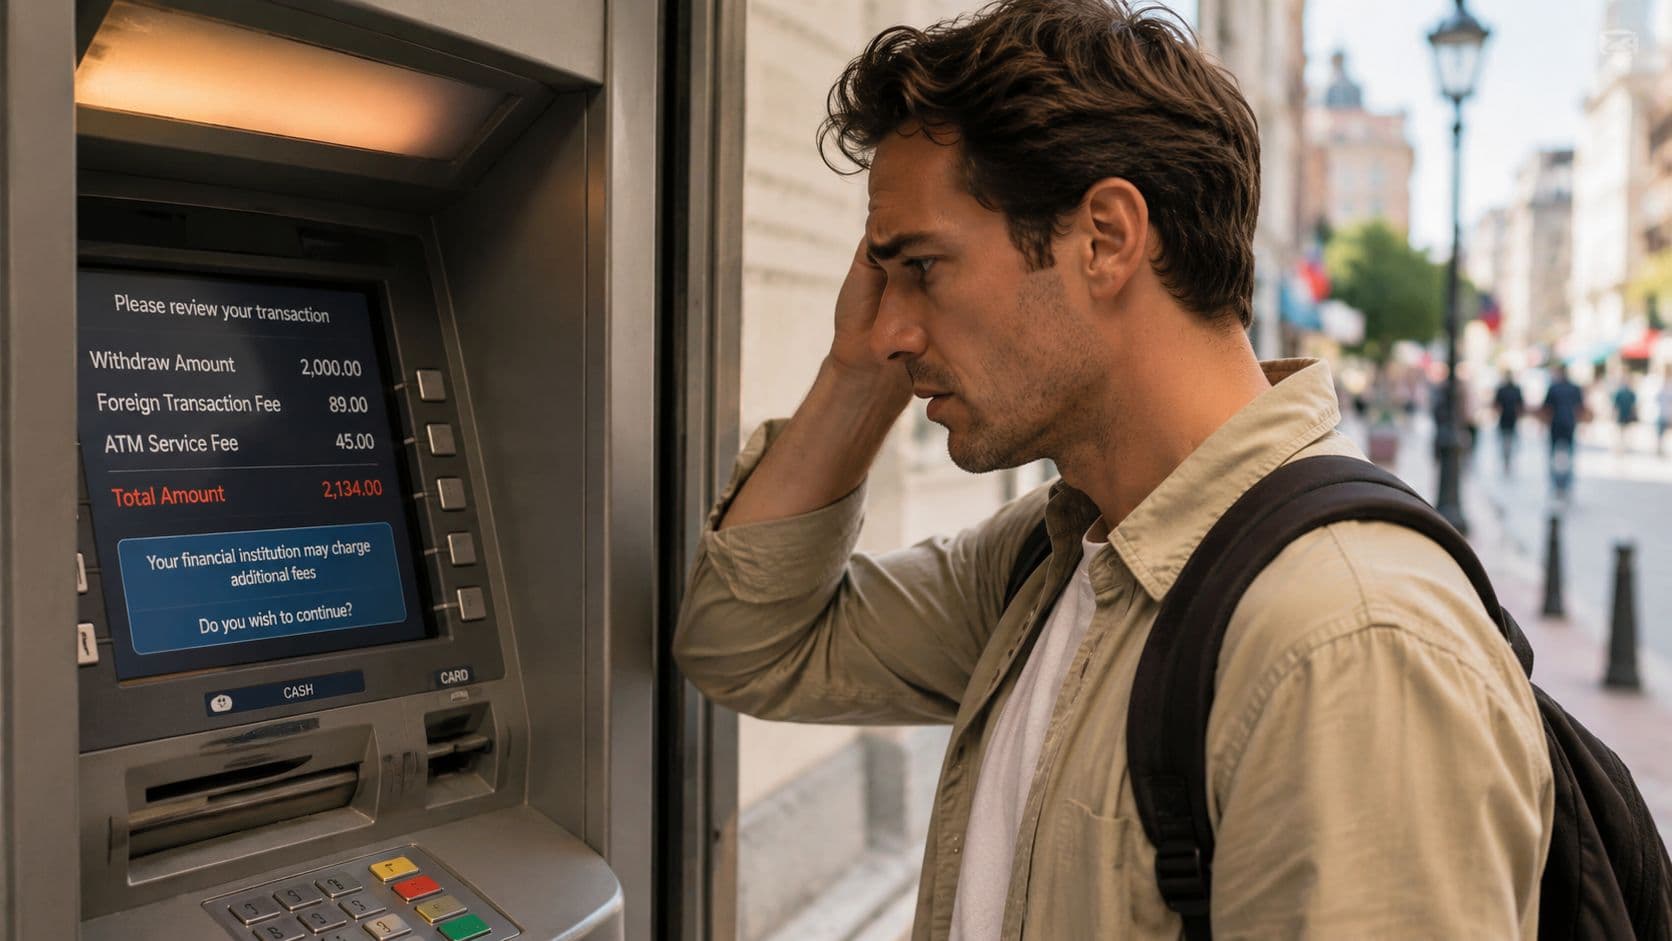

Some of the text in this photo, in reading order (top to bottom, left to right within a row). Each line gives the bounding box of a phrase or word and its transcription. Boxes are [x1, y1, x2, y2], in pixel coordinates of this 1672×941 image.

[115, 294, 329, 323] Please review your transaction
[89, 351, 235, 372] Withdraw Amount
[300, 359, 361, 378] 2,000.00
[97, 393, 280, 415] Foreign Transaction Fee
[329, 396, 368, 413] 89.00
[105, 434, 238, 453] ATM Service Fee
[336, 433, 374, 449] 45.00
[112, 486, 225, 507] Total Amount
[322, 480, 382, 499] 2,134.00
[147, 540, 370, 570] Your financial institution may charge
[231, 566, 316, 586] additional fees
[199, 602, 352, 634] Do you wish to continue?
[440, 669, 468, 684] CARD
[284, 684, 313, 698] CASH
